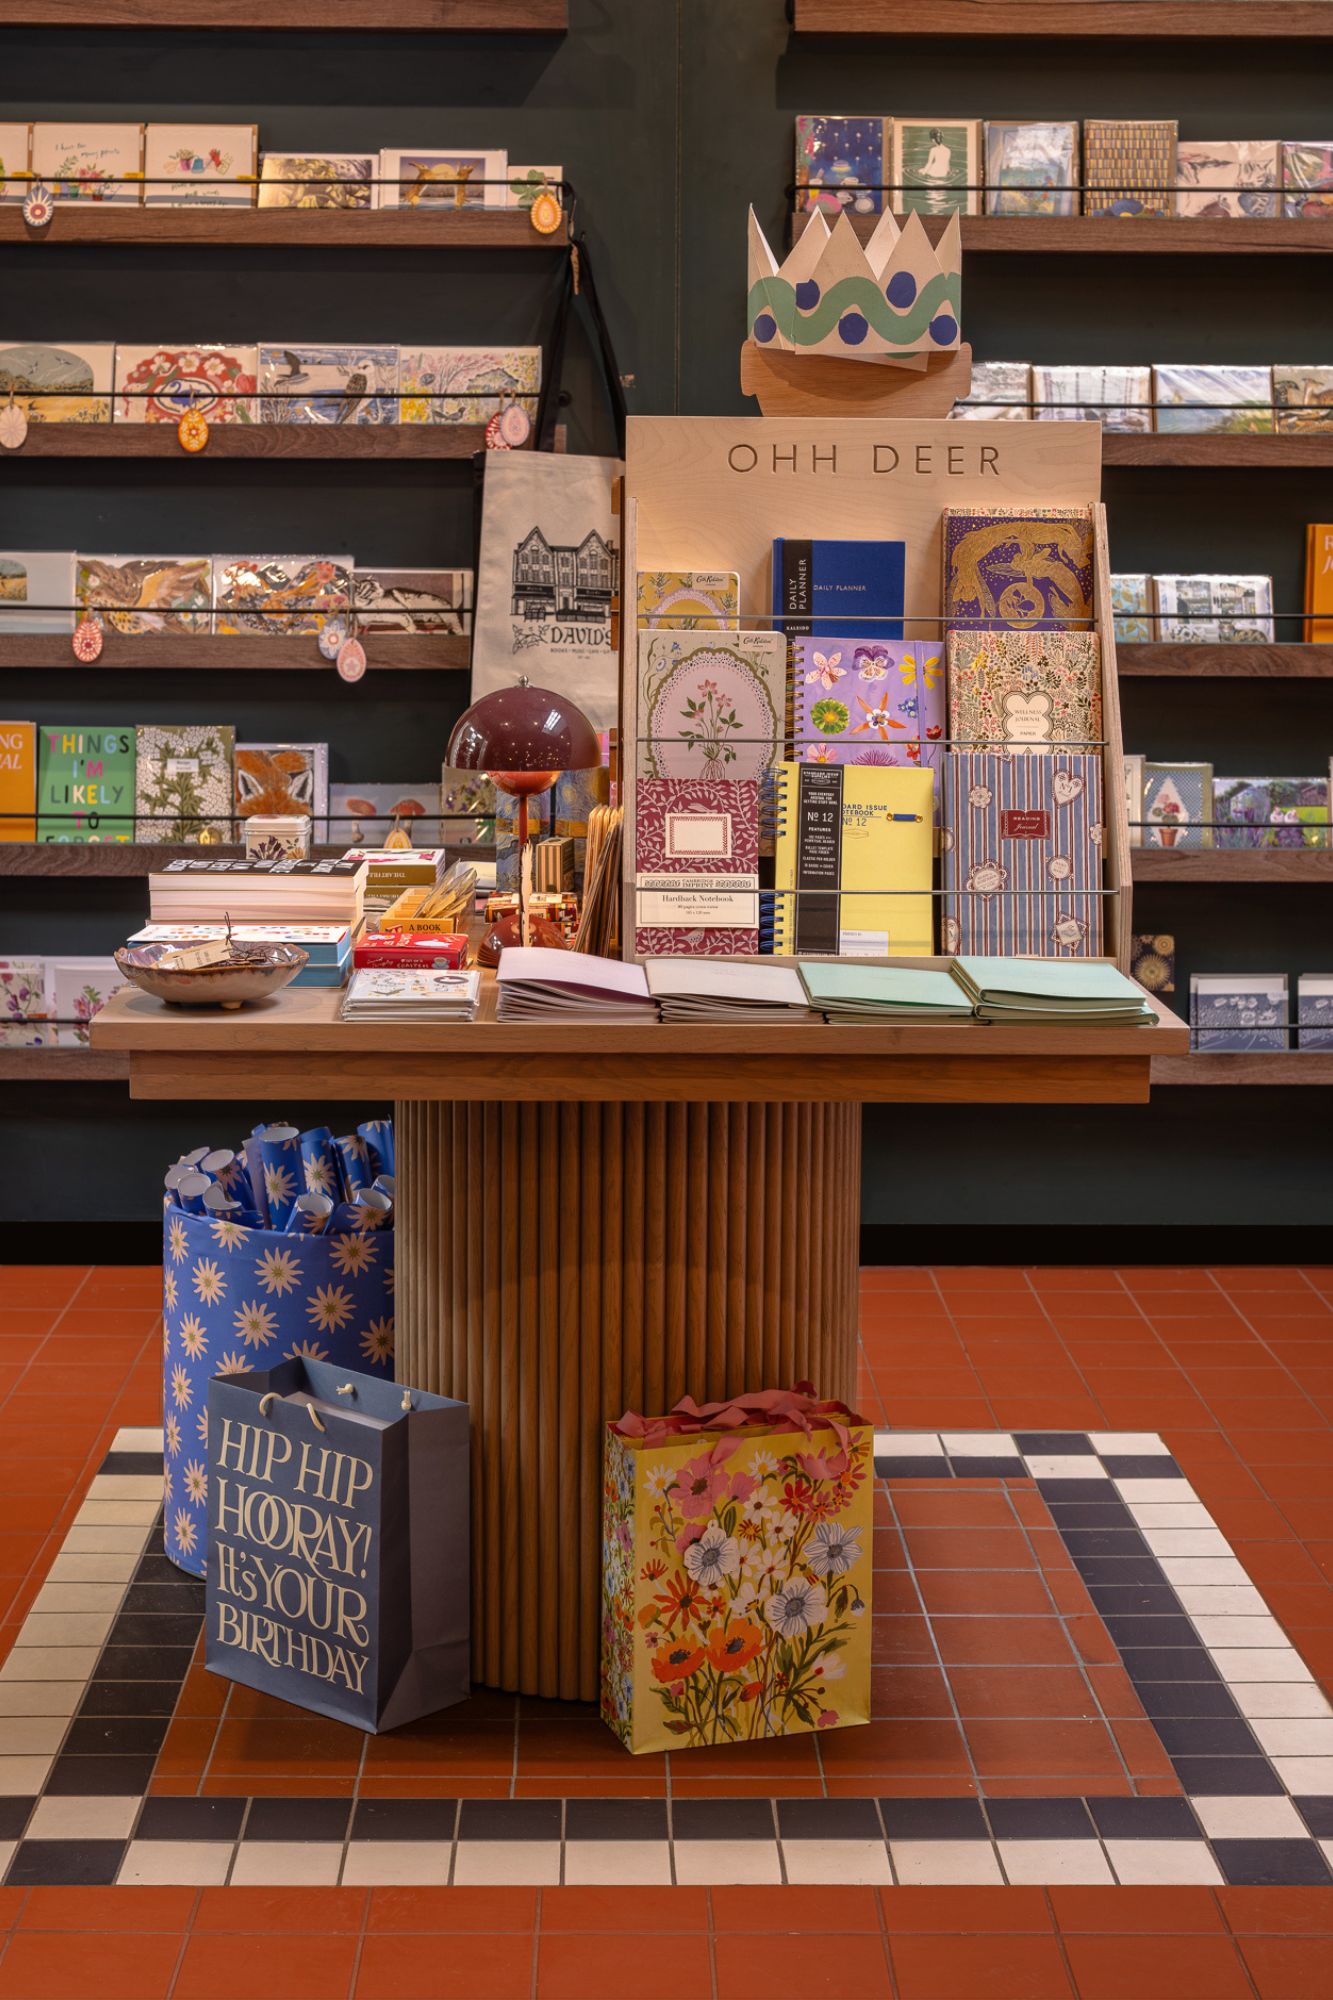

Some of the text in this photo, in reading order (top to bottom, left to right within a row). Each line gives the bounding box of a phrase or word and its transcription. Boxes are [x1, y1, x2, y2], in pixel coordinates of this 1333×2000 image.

[728, 444, 1000, 475] OHH DEER
[789, 579, 798, 610] DAILY
[799, 559, 807, 610] PLANNER
[551, 626, 612, 647] DAVID'S
[47, 733, 130, 753] THINGS
[72, 759, 103, 779] I'M
[50, 784, 124, 804] LIKELY
[72, 811, 99, 830] TO
[821, 812, 834, 823] 12
[857, 817, 867, 827] 12
[1013, 823, 1039, 832] Journal
[662, 894, 733, 902] Hardback Notebook
[216, 1418, 373, 1509] HIP HIP
[215, 1476, 372, 1581] HOORAY!
[215, 1541, 369, 1647] It's YOUR
[215, 1602, 368, 1695] BIRTHDAY
